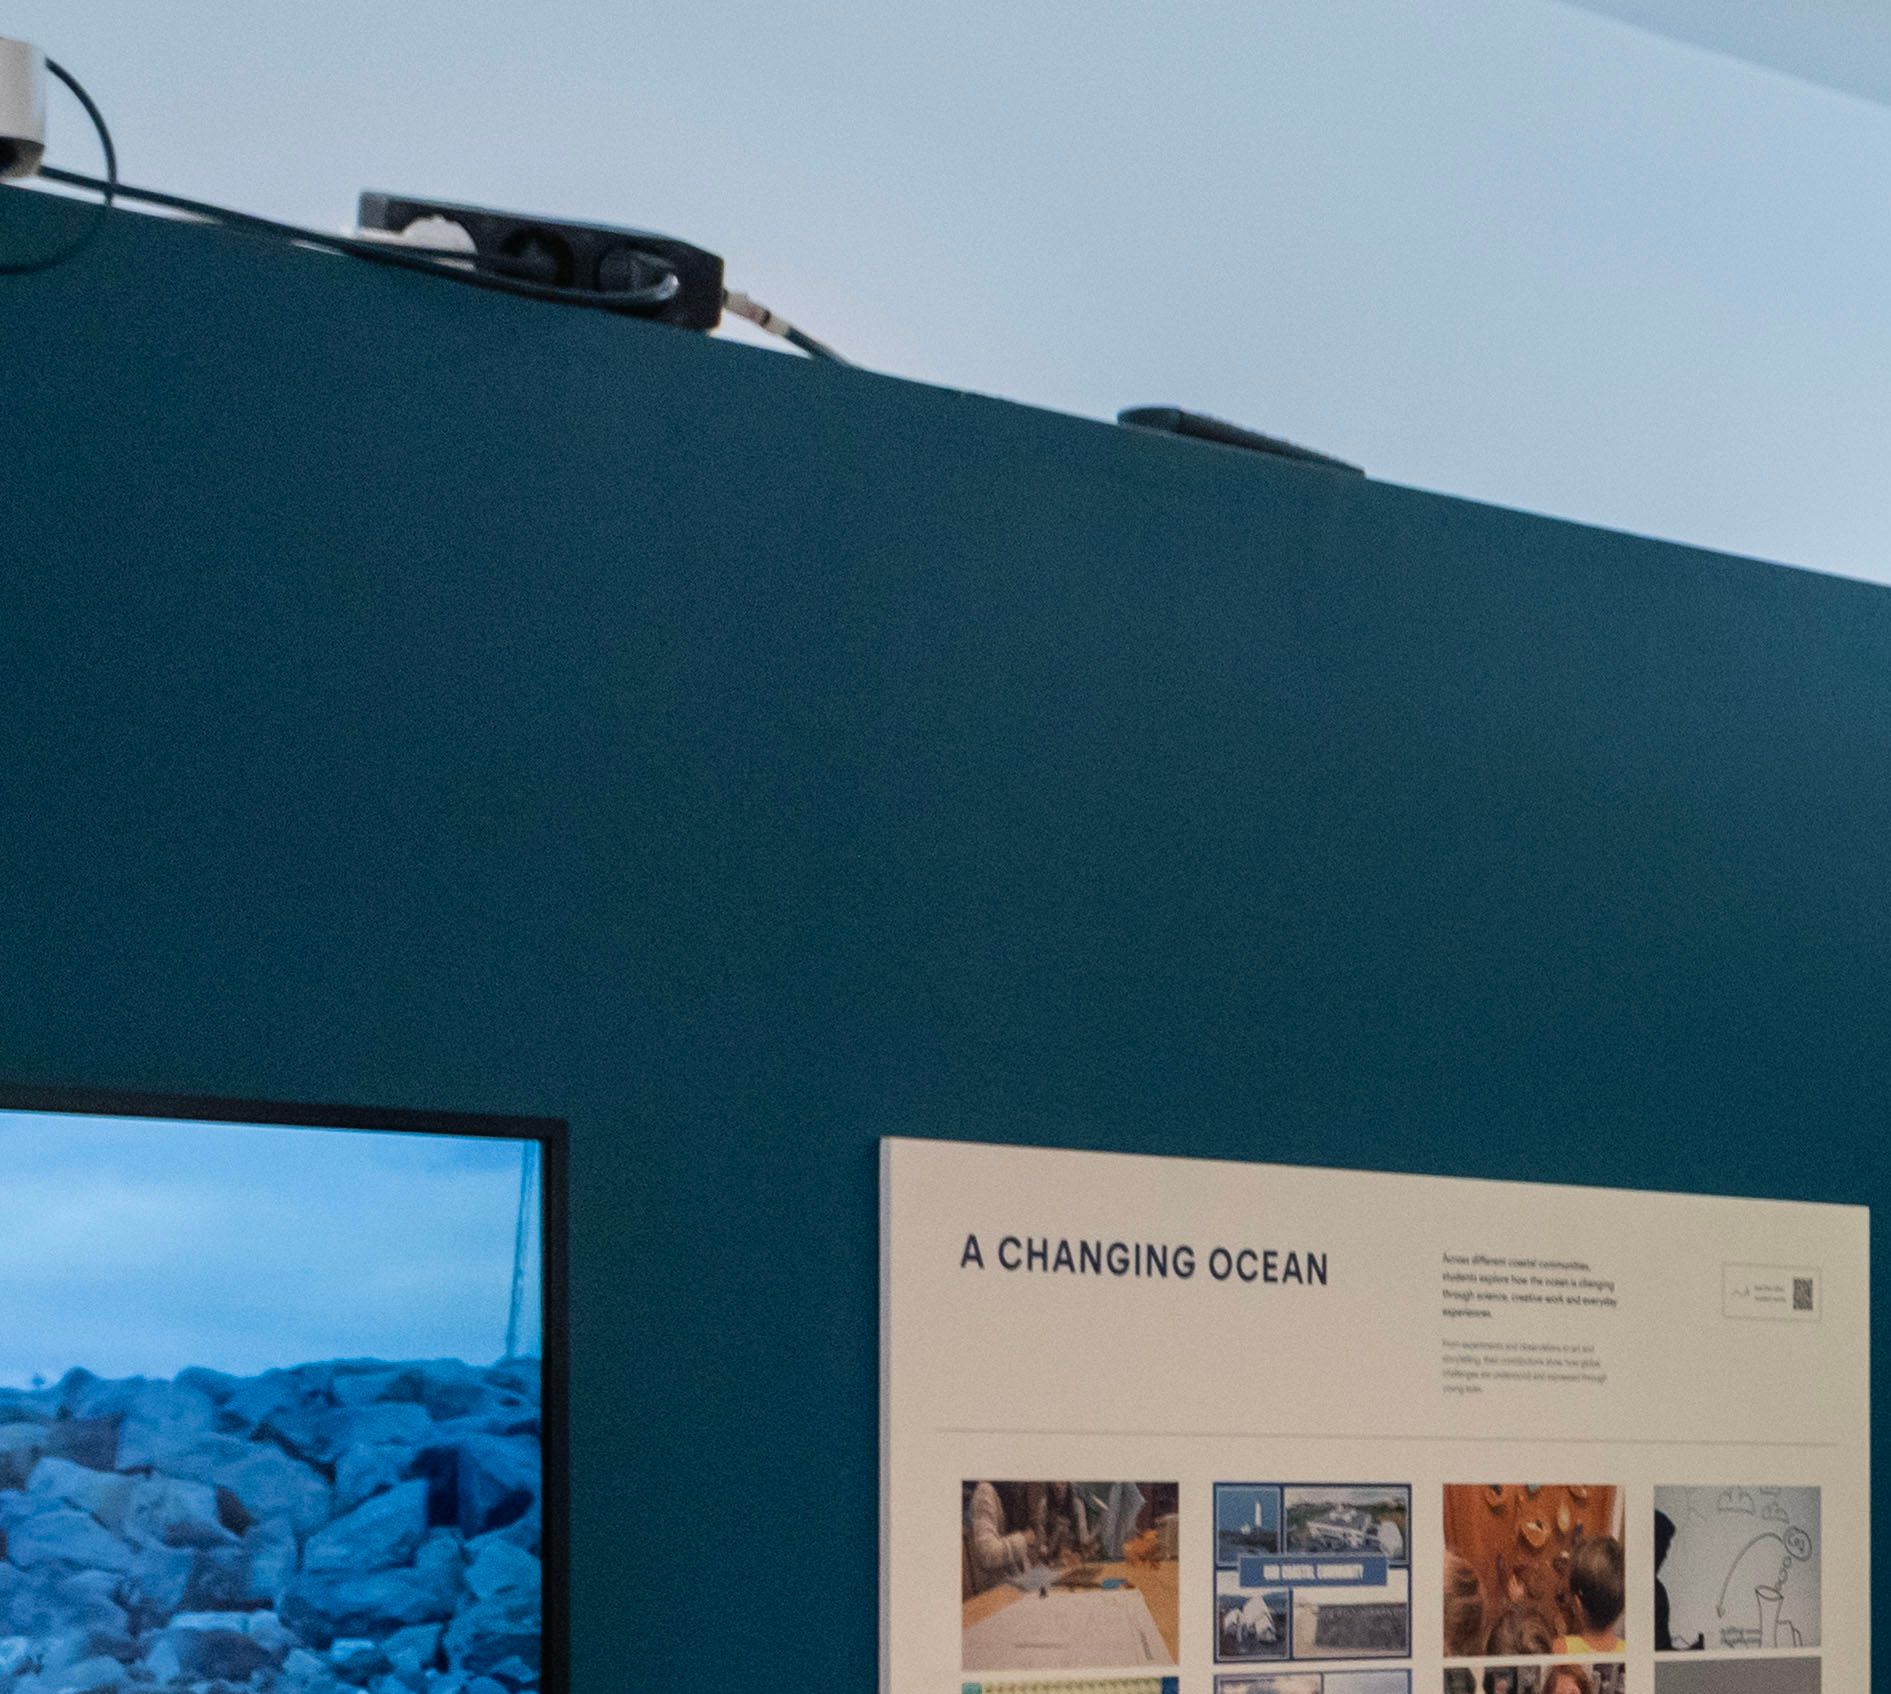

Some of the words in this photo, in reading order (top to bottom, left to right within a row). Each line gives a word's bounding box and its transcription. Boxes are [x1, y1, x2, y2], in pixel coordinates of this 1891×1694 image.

[961, 1234, 984, 1269] A
[998, 1236, 1196, 1279] CHANGING
[1209, 1247, 1328, 1285] OCEAN
